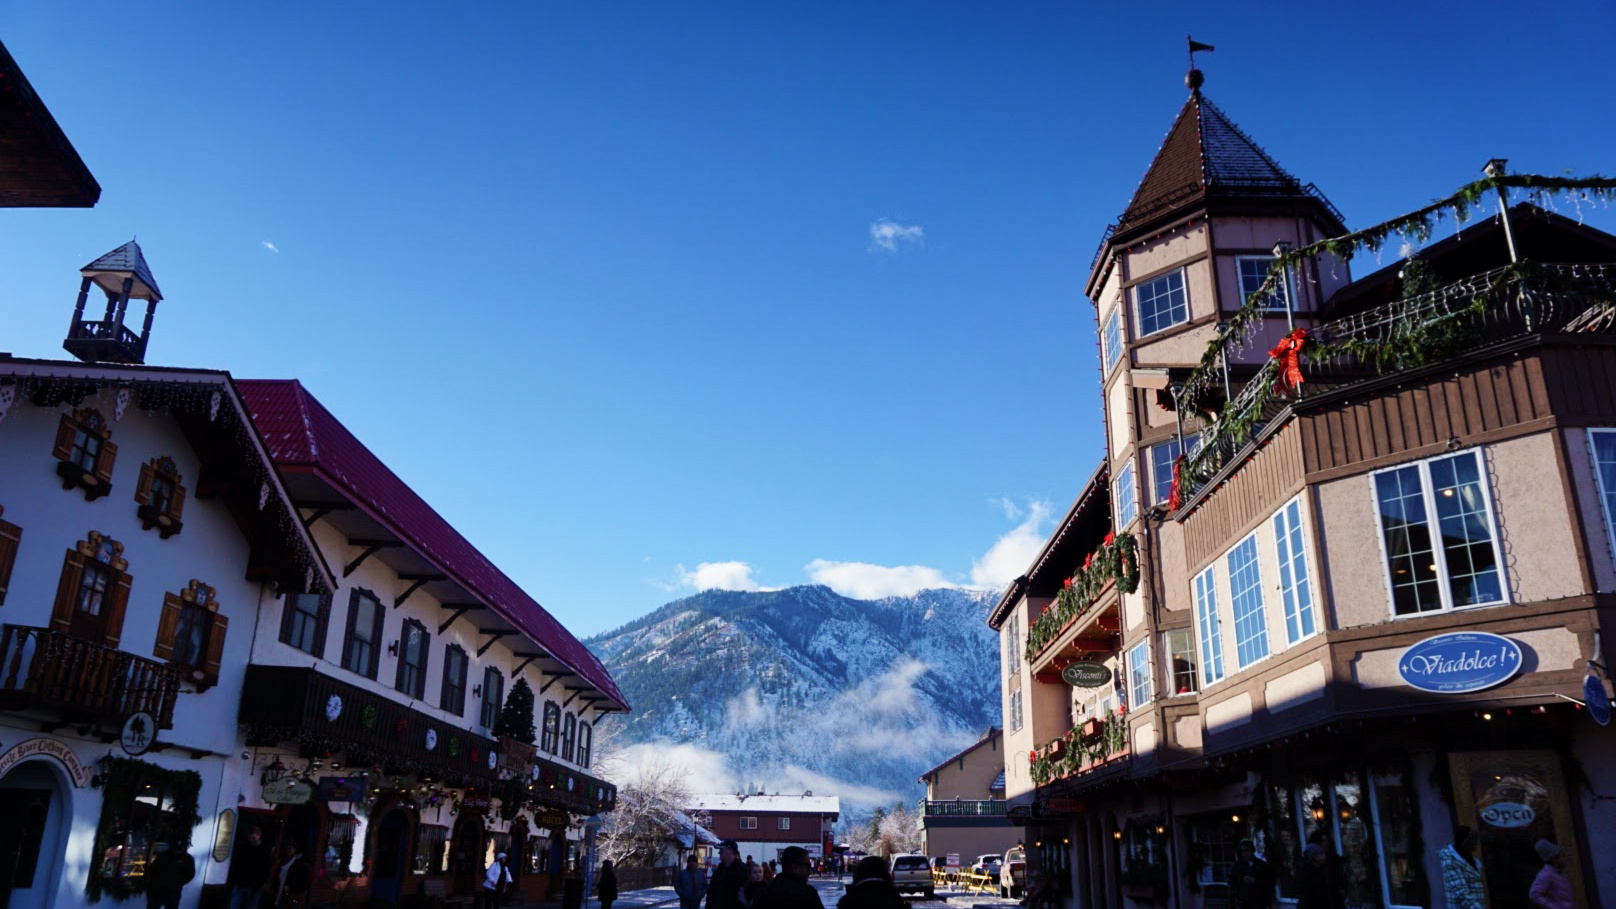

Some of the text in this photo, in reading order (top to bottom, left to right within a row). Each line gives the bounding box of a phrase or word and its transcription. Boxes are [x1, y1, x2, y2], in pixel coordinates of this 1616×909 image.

[1068, 668, 1106, 680] Visconti's
[17, 743, 37, 757] River
[38, 740, 64, 756] Clothing
[63, 751, 83, 780] Company
[541, 815, 563, 826] HOTEL
[1485, 809, 1532, 823] Open
